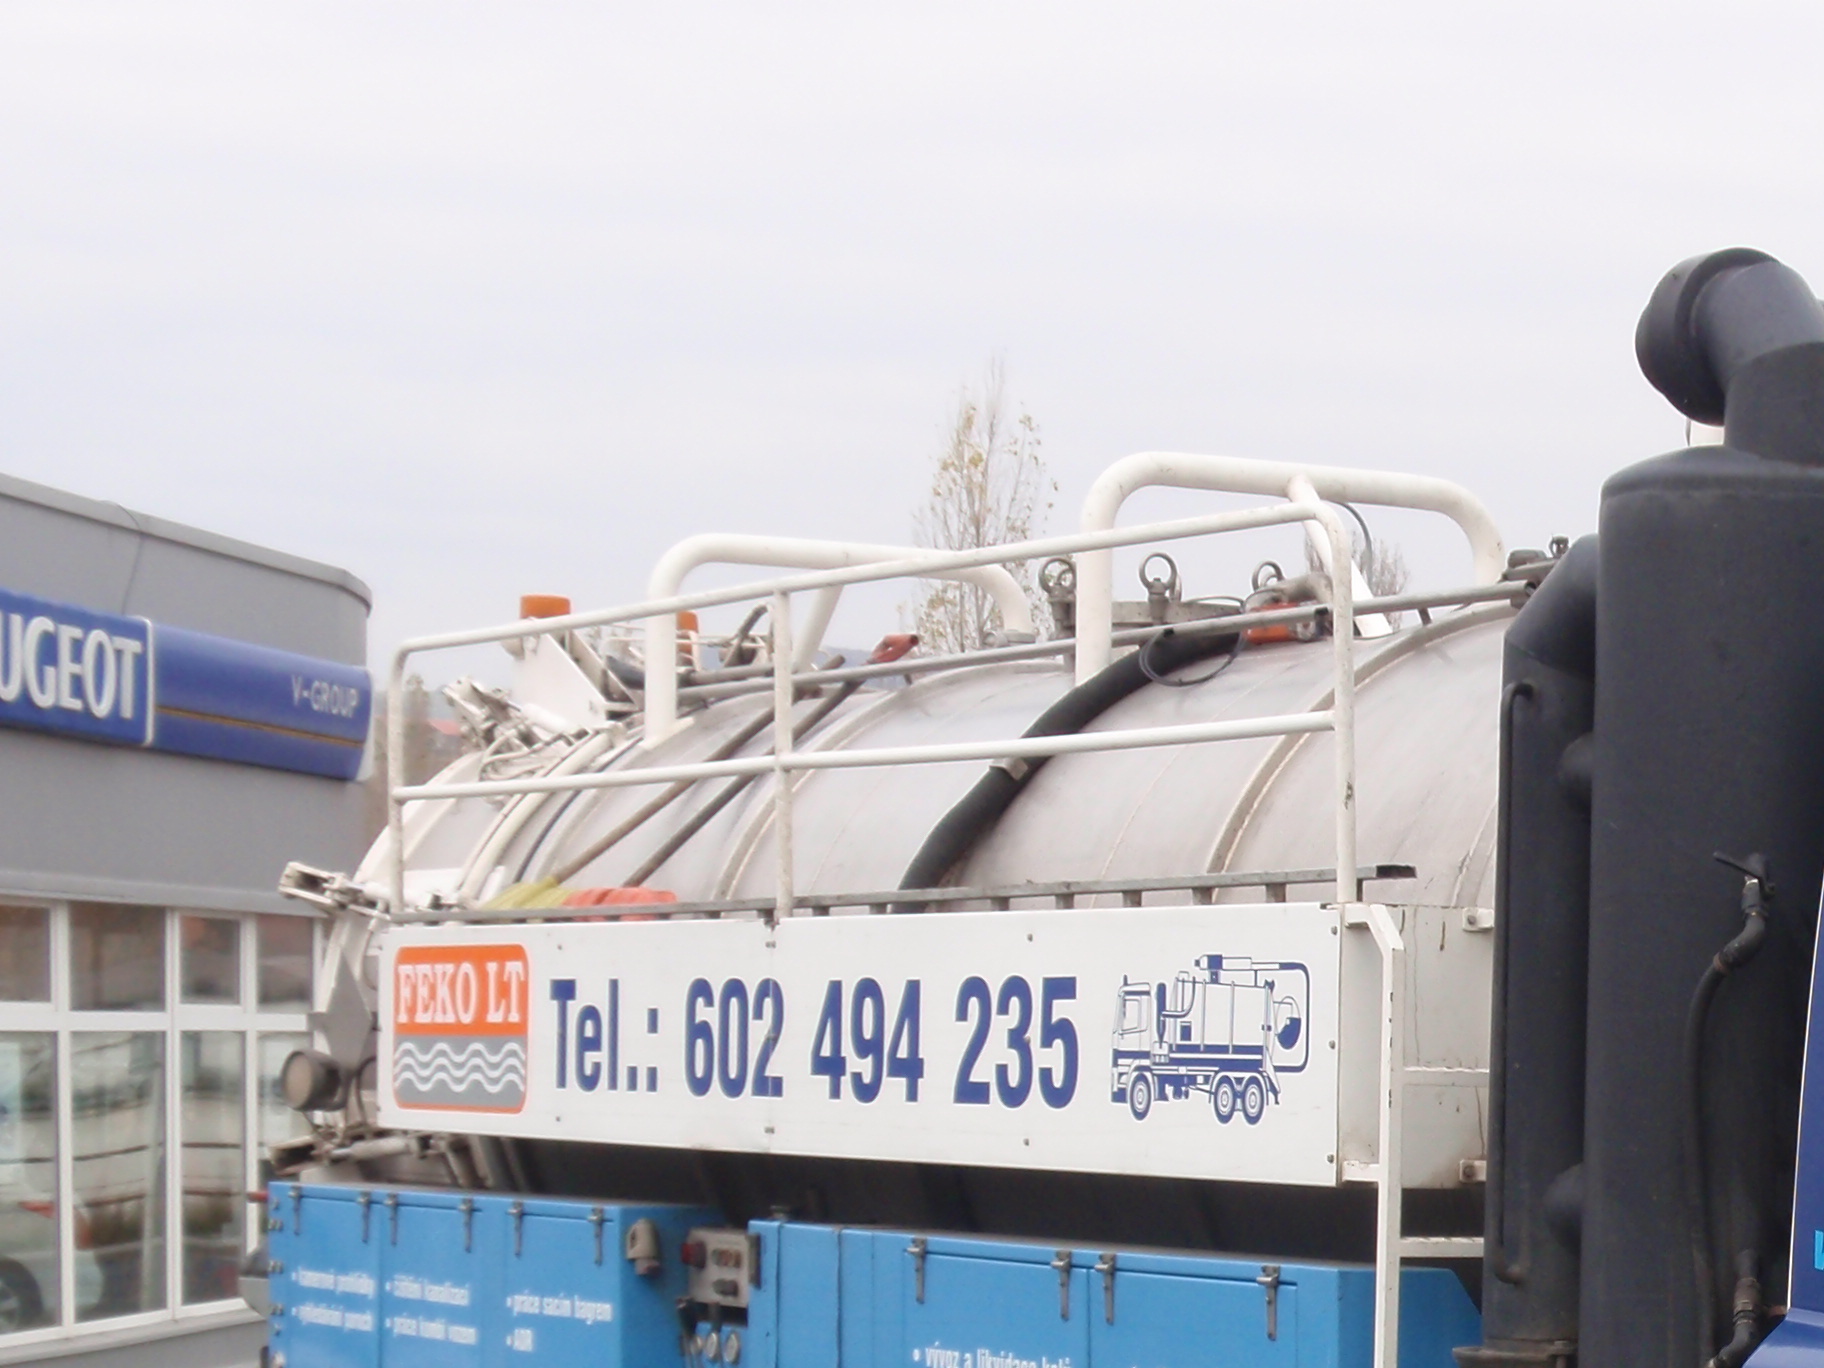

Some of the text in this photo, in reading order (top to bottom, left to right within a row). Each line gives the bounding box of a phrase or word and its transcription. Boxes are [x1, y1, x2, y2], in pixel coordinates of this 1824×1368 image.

[291, 674, 359, 718] V-GROUP
[397, 961, 525, 1025] FEKO LT
[549, 975, 1079, 1109] Tel.: 602 494 235
